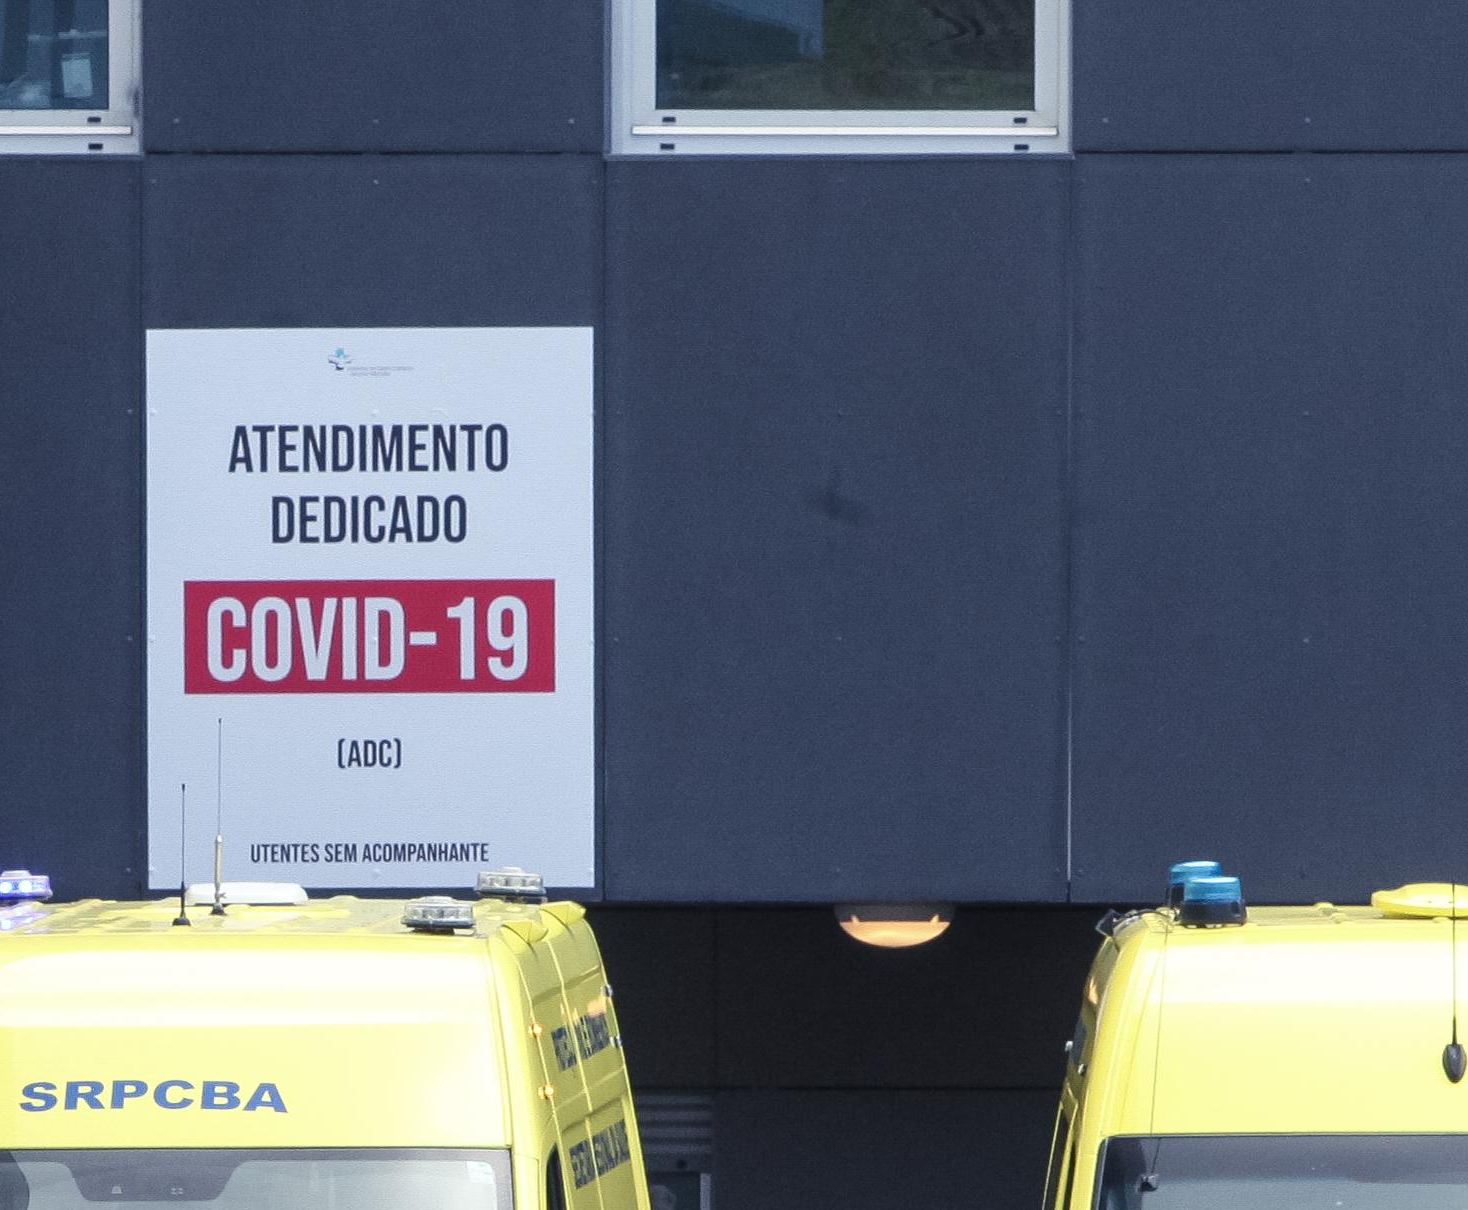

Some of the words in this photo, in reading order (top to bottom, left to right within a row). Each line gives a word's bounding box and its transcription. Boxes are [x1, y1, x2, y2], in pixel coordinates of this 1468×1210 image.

[228, 423, 509, 473] ATENDIMENTO
[271, 494, 467, 544] DEDICADO
[206, 595, 528, 682] COVID-19
[337, 738, 402, 769] (ADC)
[250, 844, 320, 864] UTENTES
[325, 844, 358, 863] SEM
[362, 843, 489, 863] ACOMPANHANTE
[20, 1080, 288, 1113] SRPCBA
